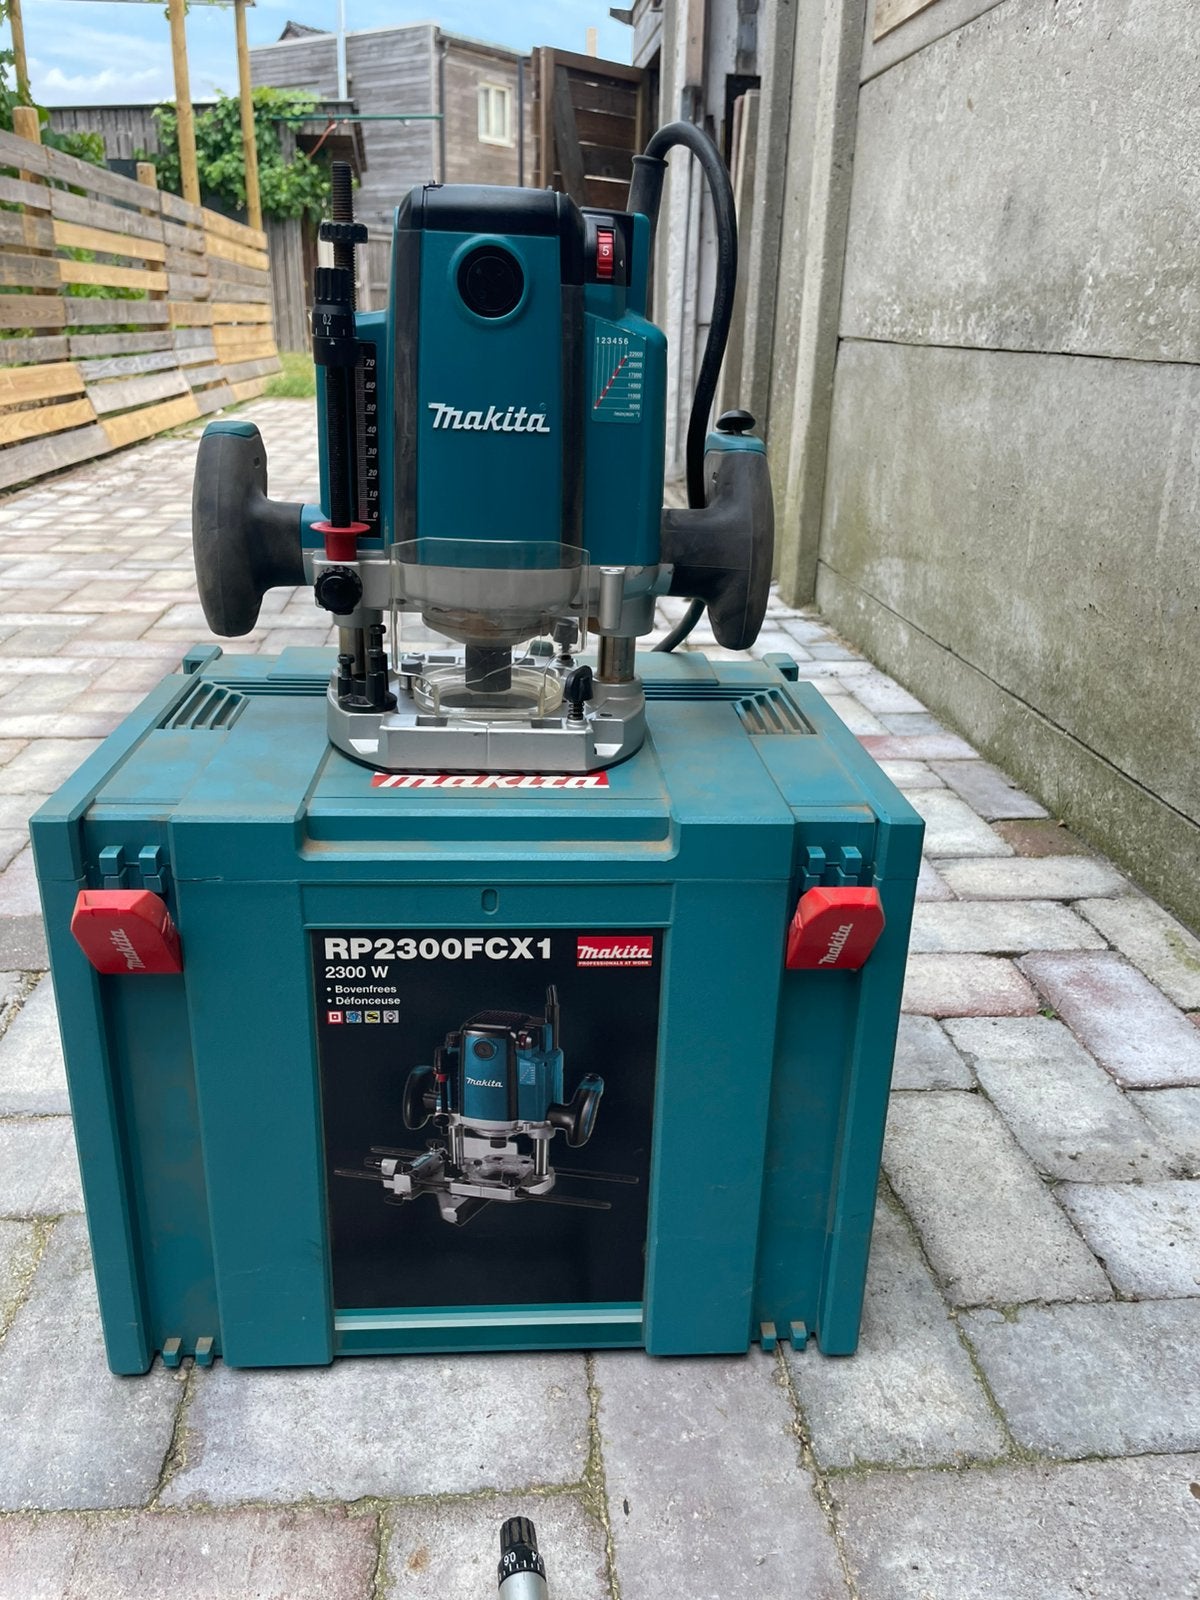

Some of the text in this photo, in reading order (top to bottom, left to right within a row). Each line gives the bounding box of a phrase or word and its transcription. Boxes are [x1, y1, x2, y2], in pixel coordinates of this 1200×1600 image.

[602, 245, 610, 256] 5
[366, 359, 376, 367] 70
[369, 490, 378, 498] 10
[324, 937, 551, 960] RP2300FCX1
[325, 965, 389, 979] 2300 W
[335, 984, 397, 994] Bovenfrees
[335, 996, 401, 1005] Défonceuse
